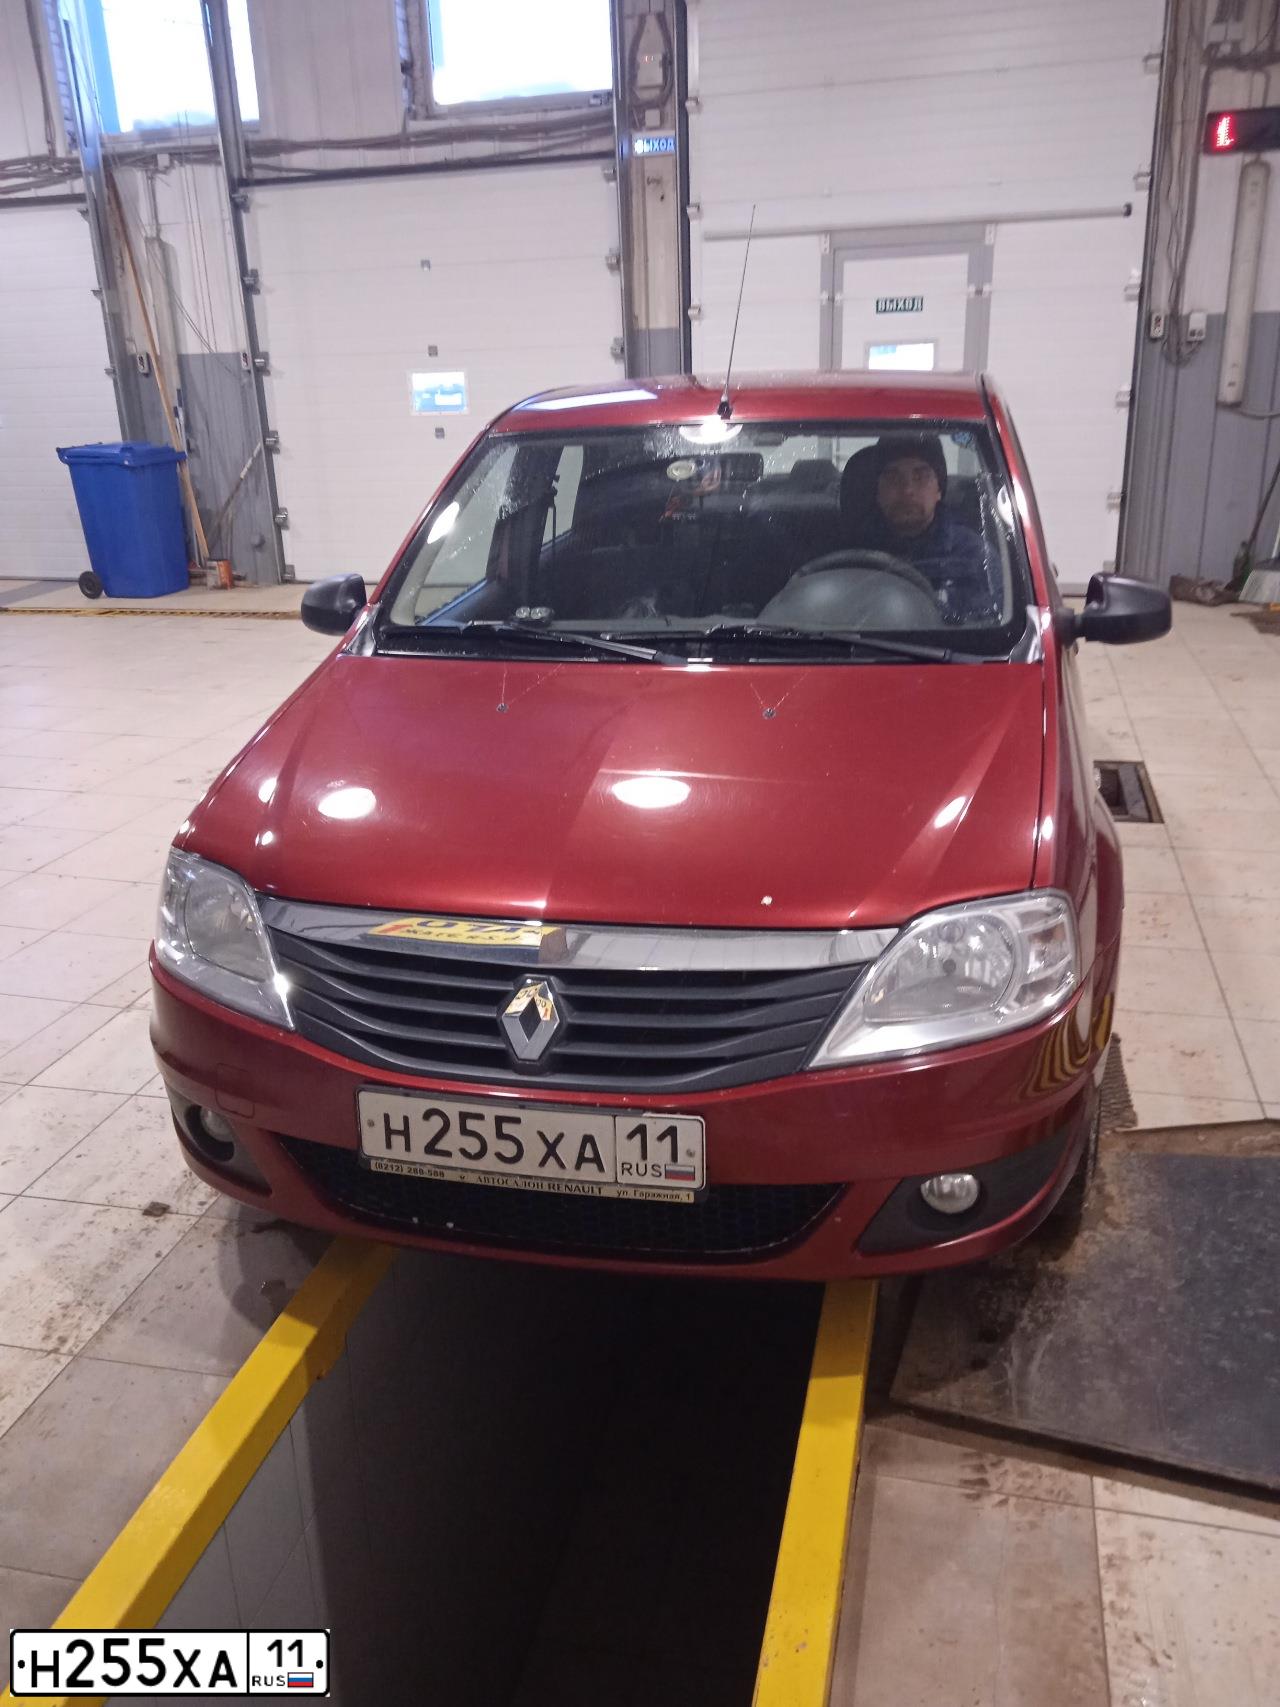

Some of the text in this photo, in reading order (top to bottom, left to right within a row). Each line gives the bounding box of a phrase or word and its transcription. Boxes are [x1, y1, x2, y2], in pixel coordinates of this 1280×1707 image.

[876, 297, 924, 314] ВЫХОД
[383, 1107, 679, 1174] Н255ХА 11
[621, 1161, 662, 1178] RUS
[547, 1181, 603, 1195] RENAULT
